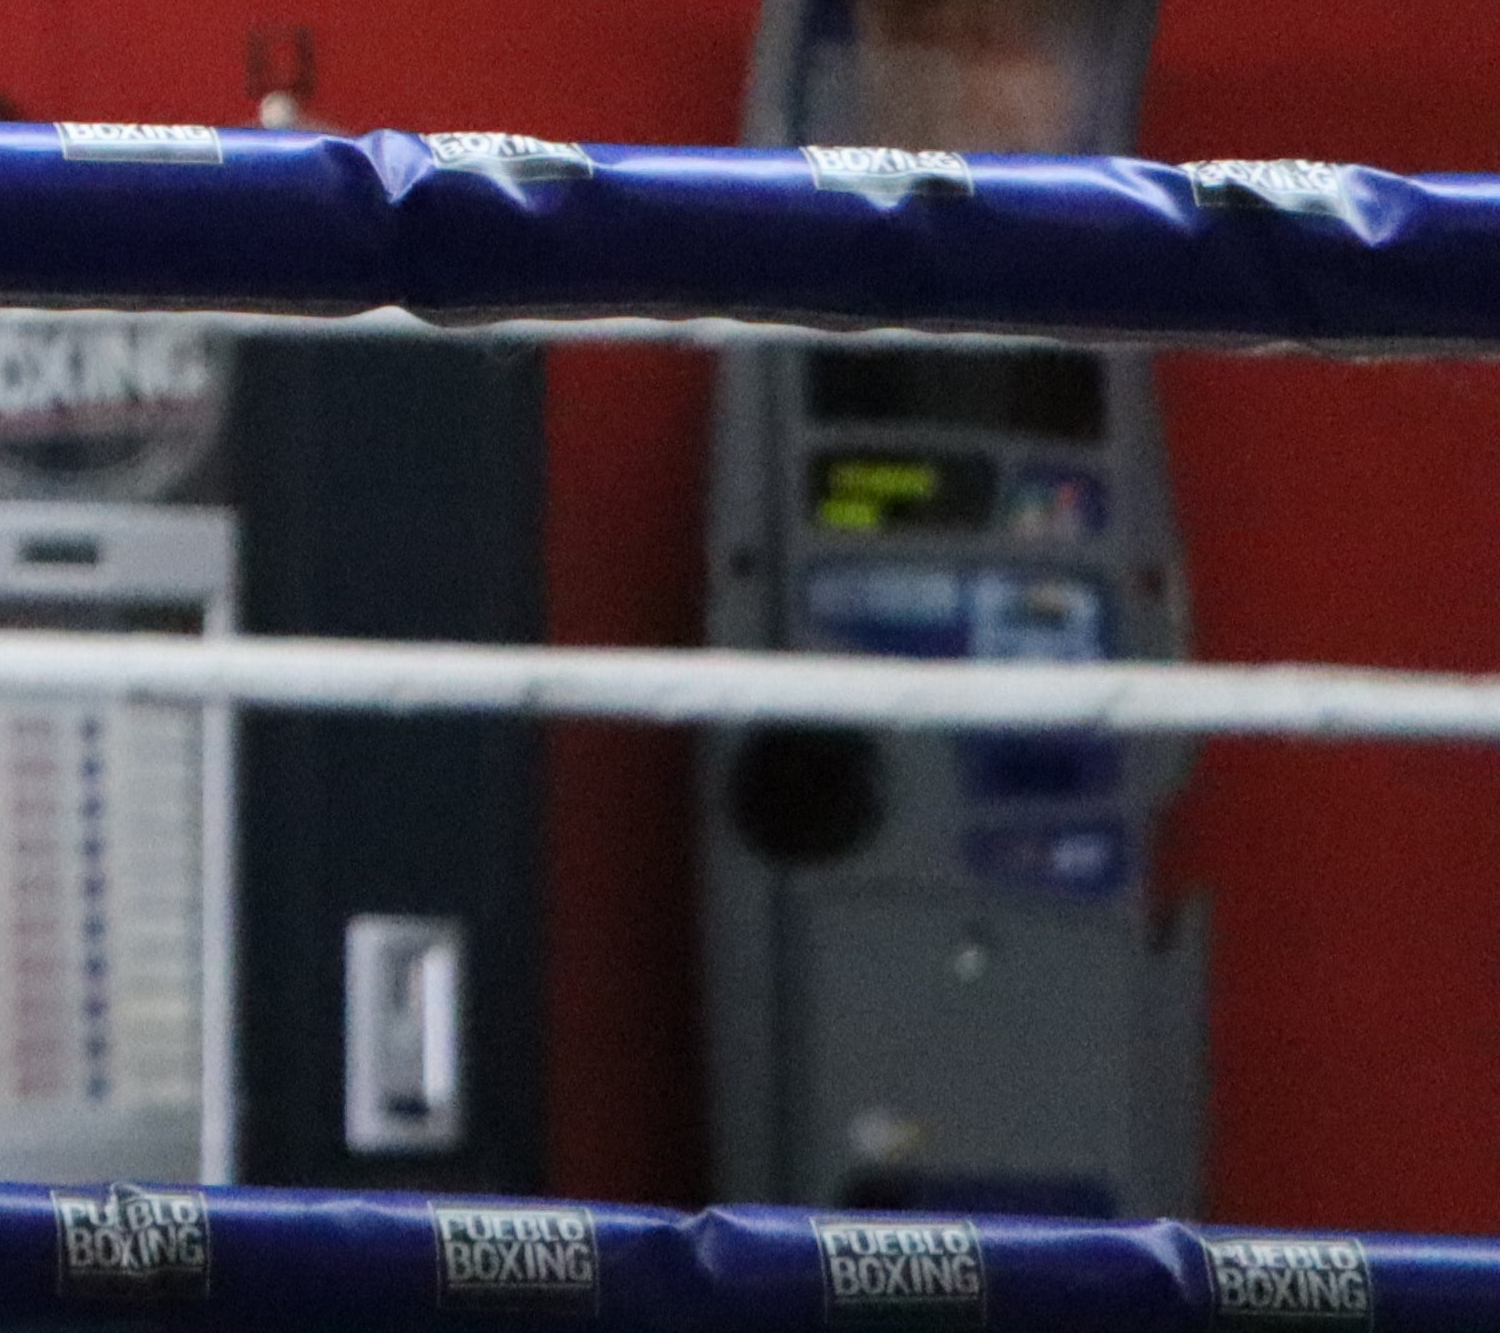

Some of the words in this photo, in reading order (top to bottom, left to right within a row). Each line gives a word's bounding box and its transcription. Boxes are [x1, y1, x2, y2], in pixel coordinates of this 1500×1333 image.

[71, 124, 209, 140] BOXING
[440, 1213, 587, 1241] PUEBLO
[823, 1231, 970, 1256] PUEBLO
[67, 1227, 206, 1271] BOXING
[445, 1241, 591, 1282] BOXING
[1212, 1243, 1358, 1270] PUEBLO
[831, 1255, 979, 1297] BOXING
[1218, 1269, 1367, 1310] BOXING
